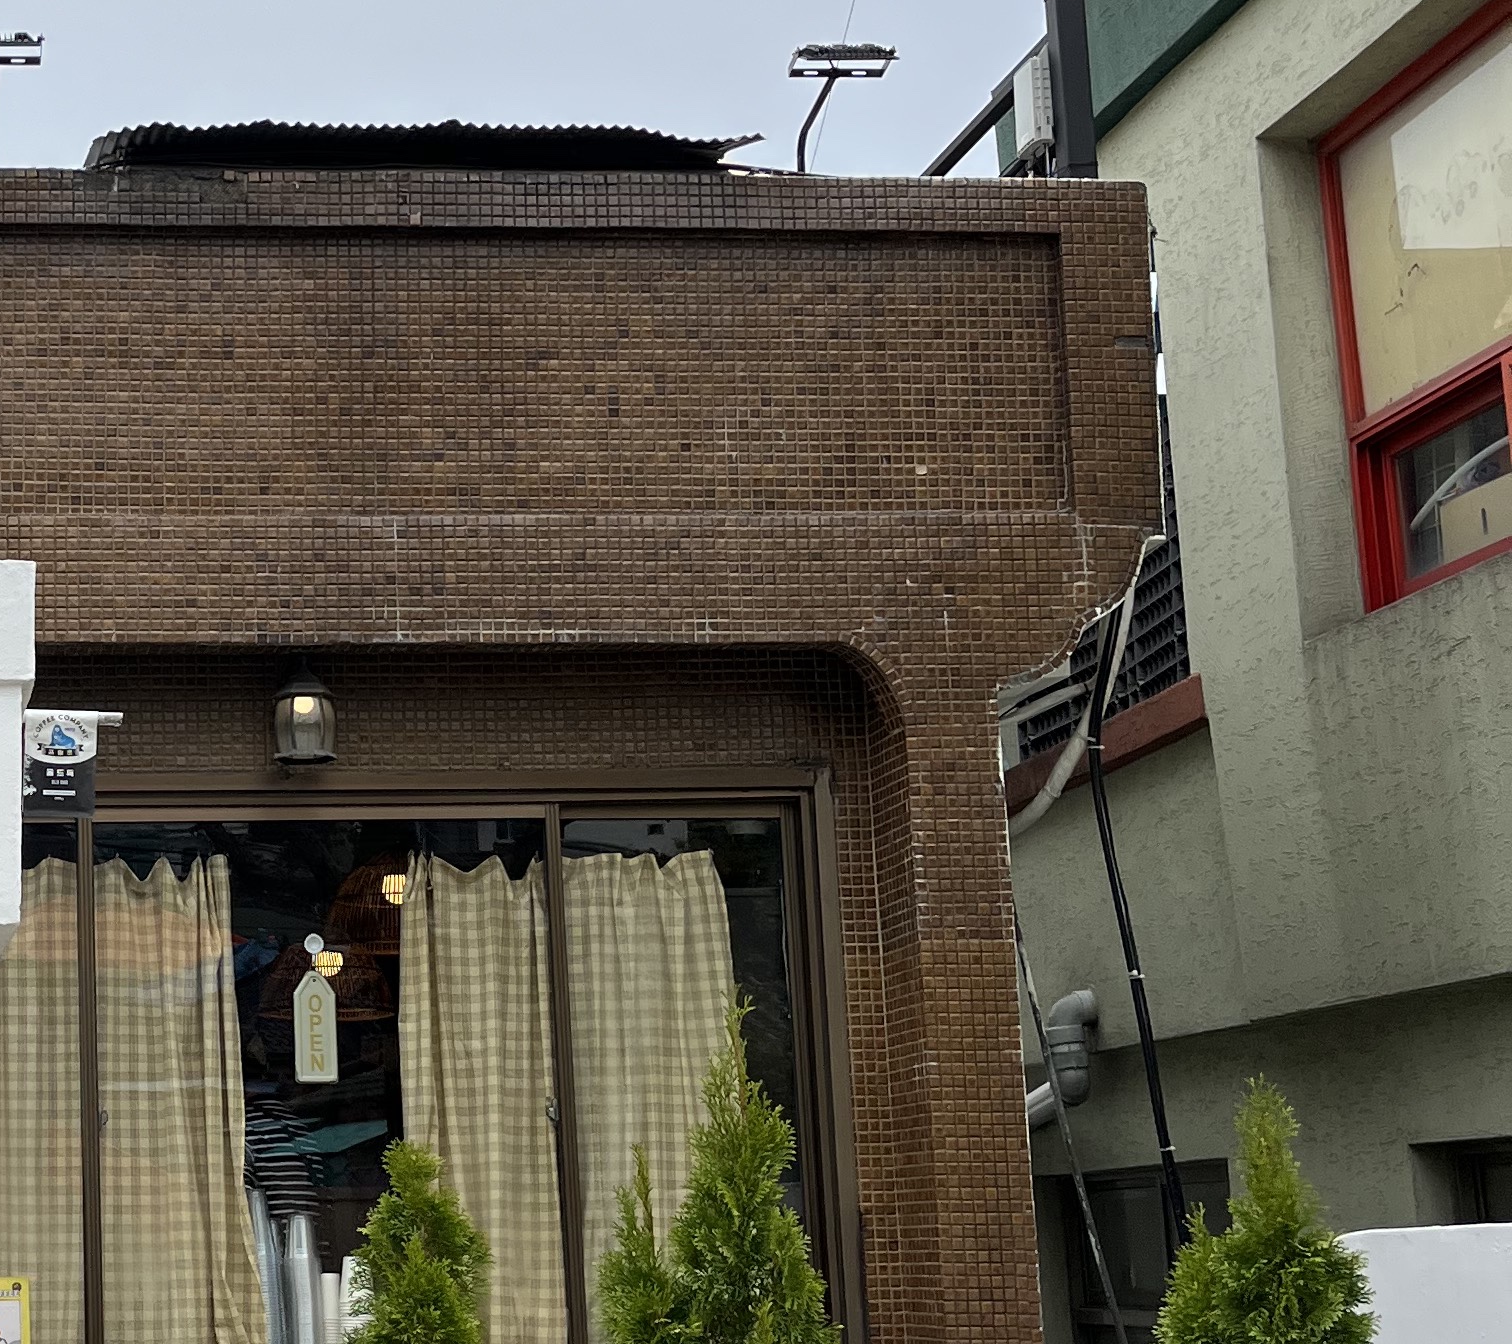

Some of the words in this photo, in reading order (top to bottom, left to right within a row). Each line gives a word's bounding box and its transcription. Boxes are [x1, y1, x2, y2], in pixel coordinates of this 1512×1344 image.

[32, 715, 55, 739] COFFEE
[58, 714, 89, 739] COMPANY
[308, 994, 325, 1072] OPEN
